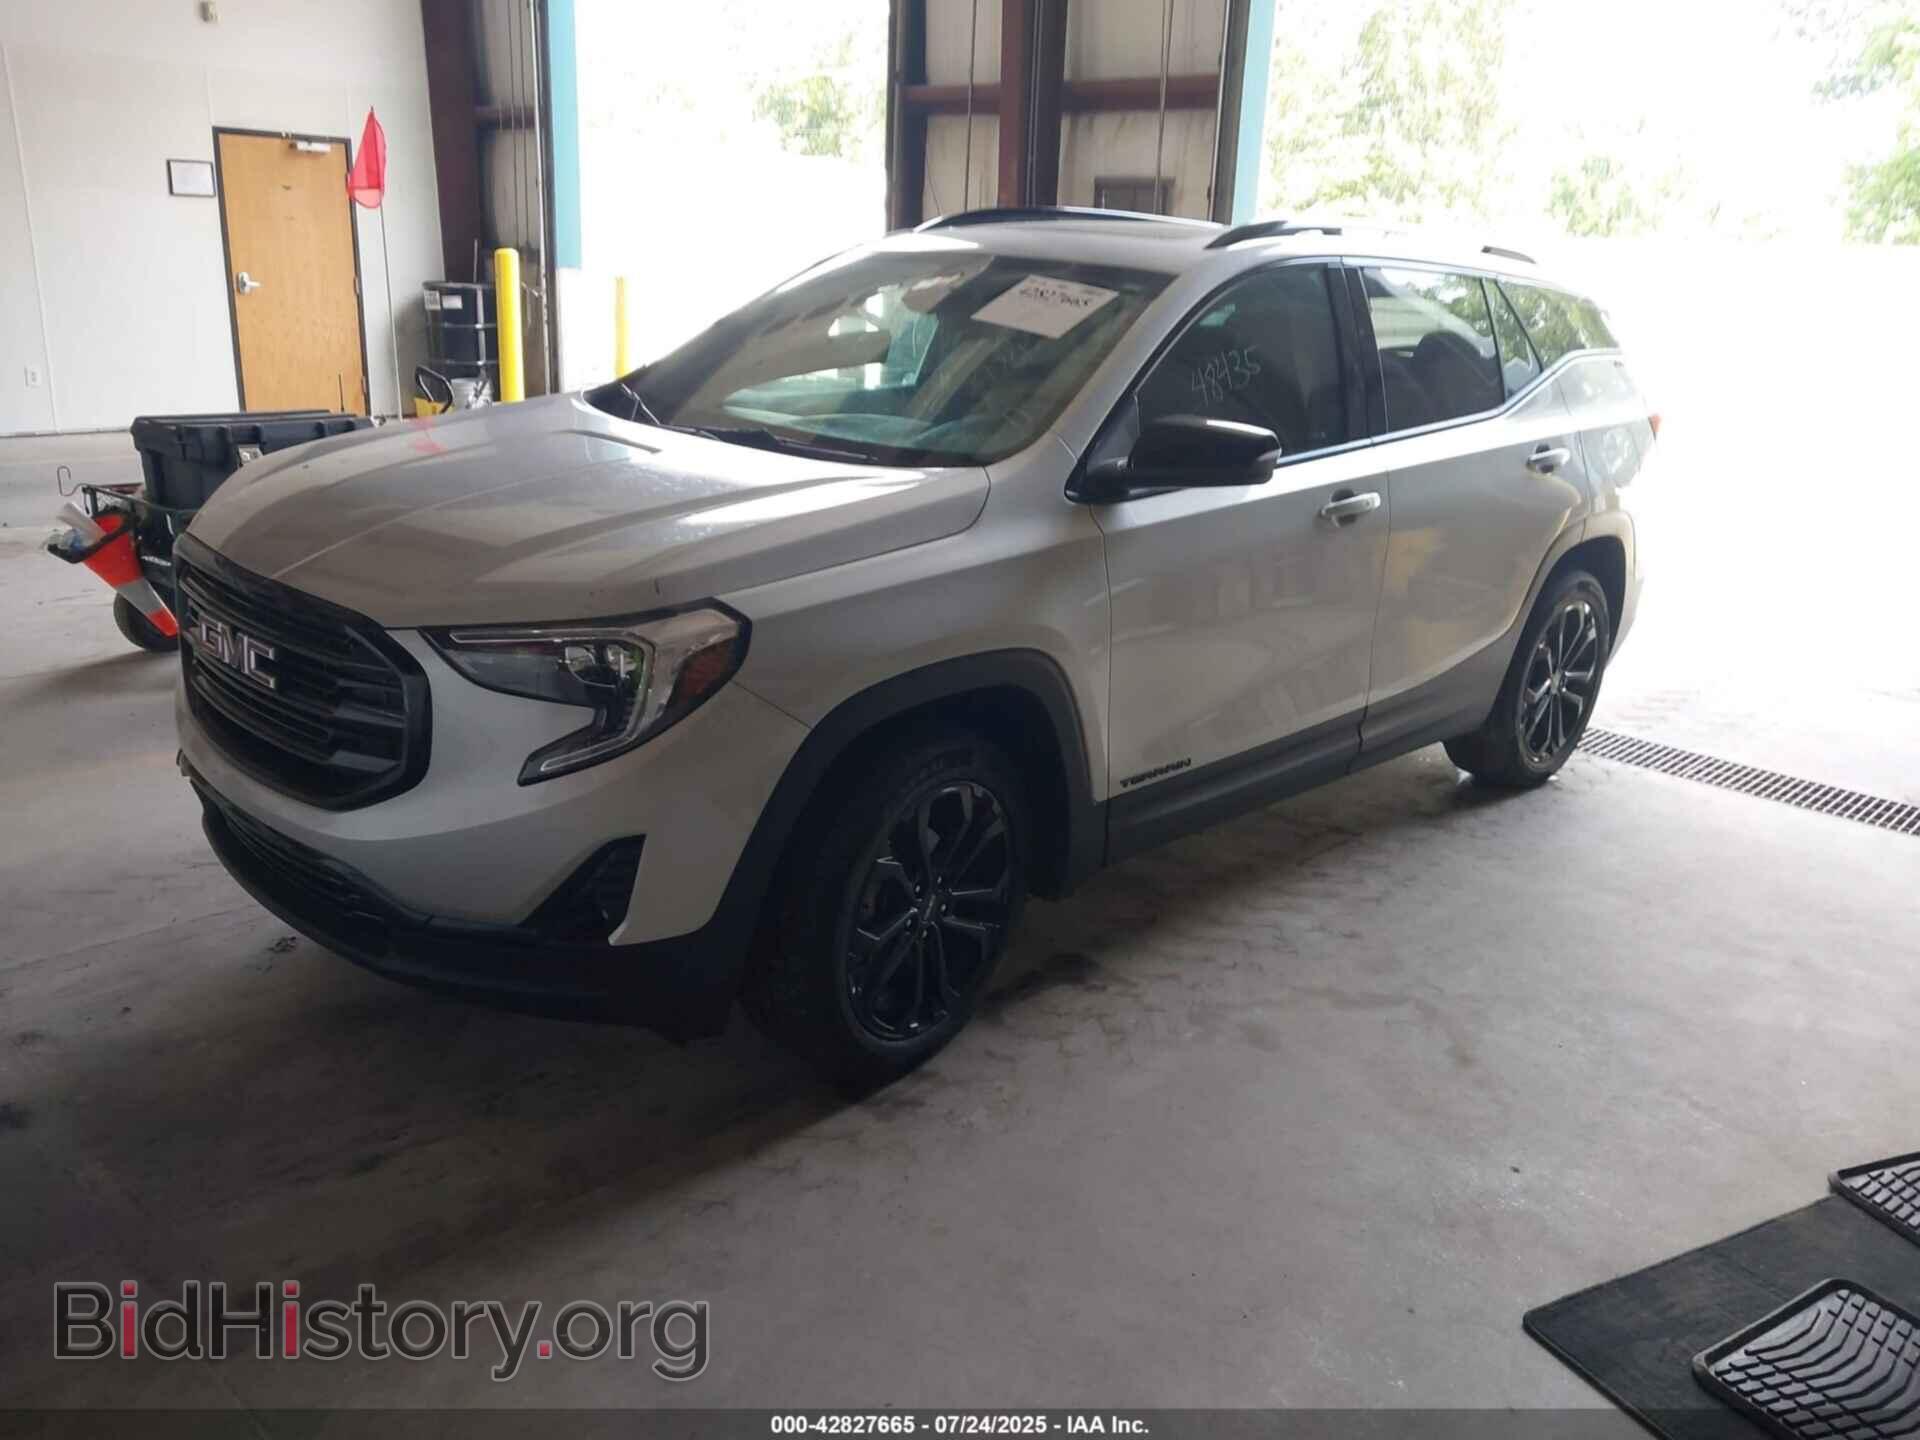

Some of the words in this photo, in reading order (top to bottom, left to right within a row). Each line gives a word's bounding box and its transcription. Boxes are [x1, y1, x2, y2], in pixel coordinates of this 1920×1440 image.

[1191, 345, 1261, 406] 48435
[200, 619, 275, 689] GMC
[1119, 757, 1192, 788] TERRAIN
